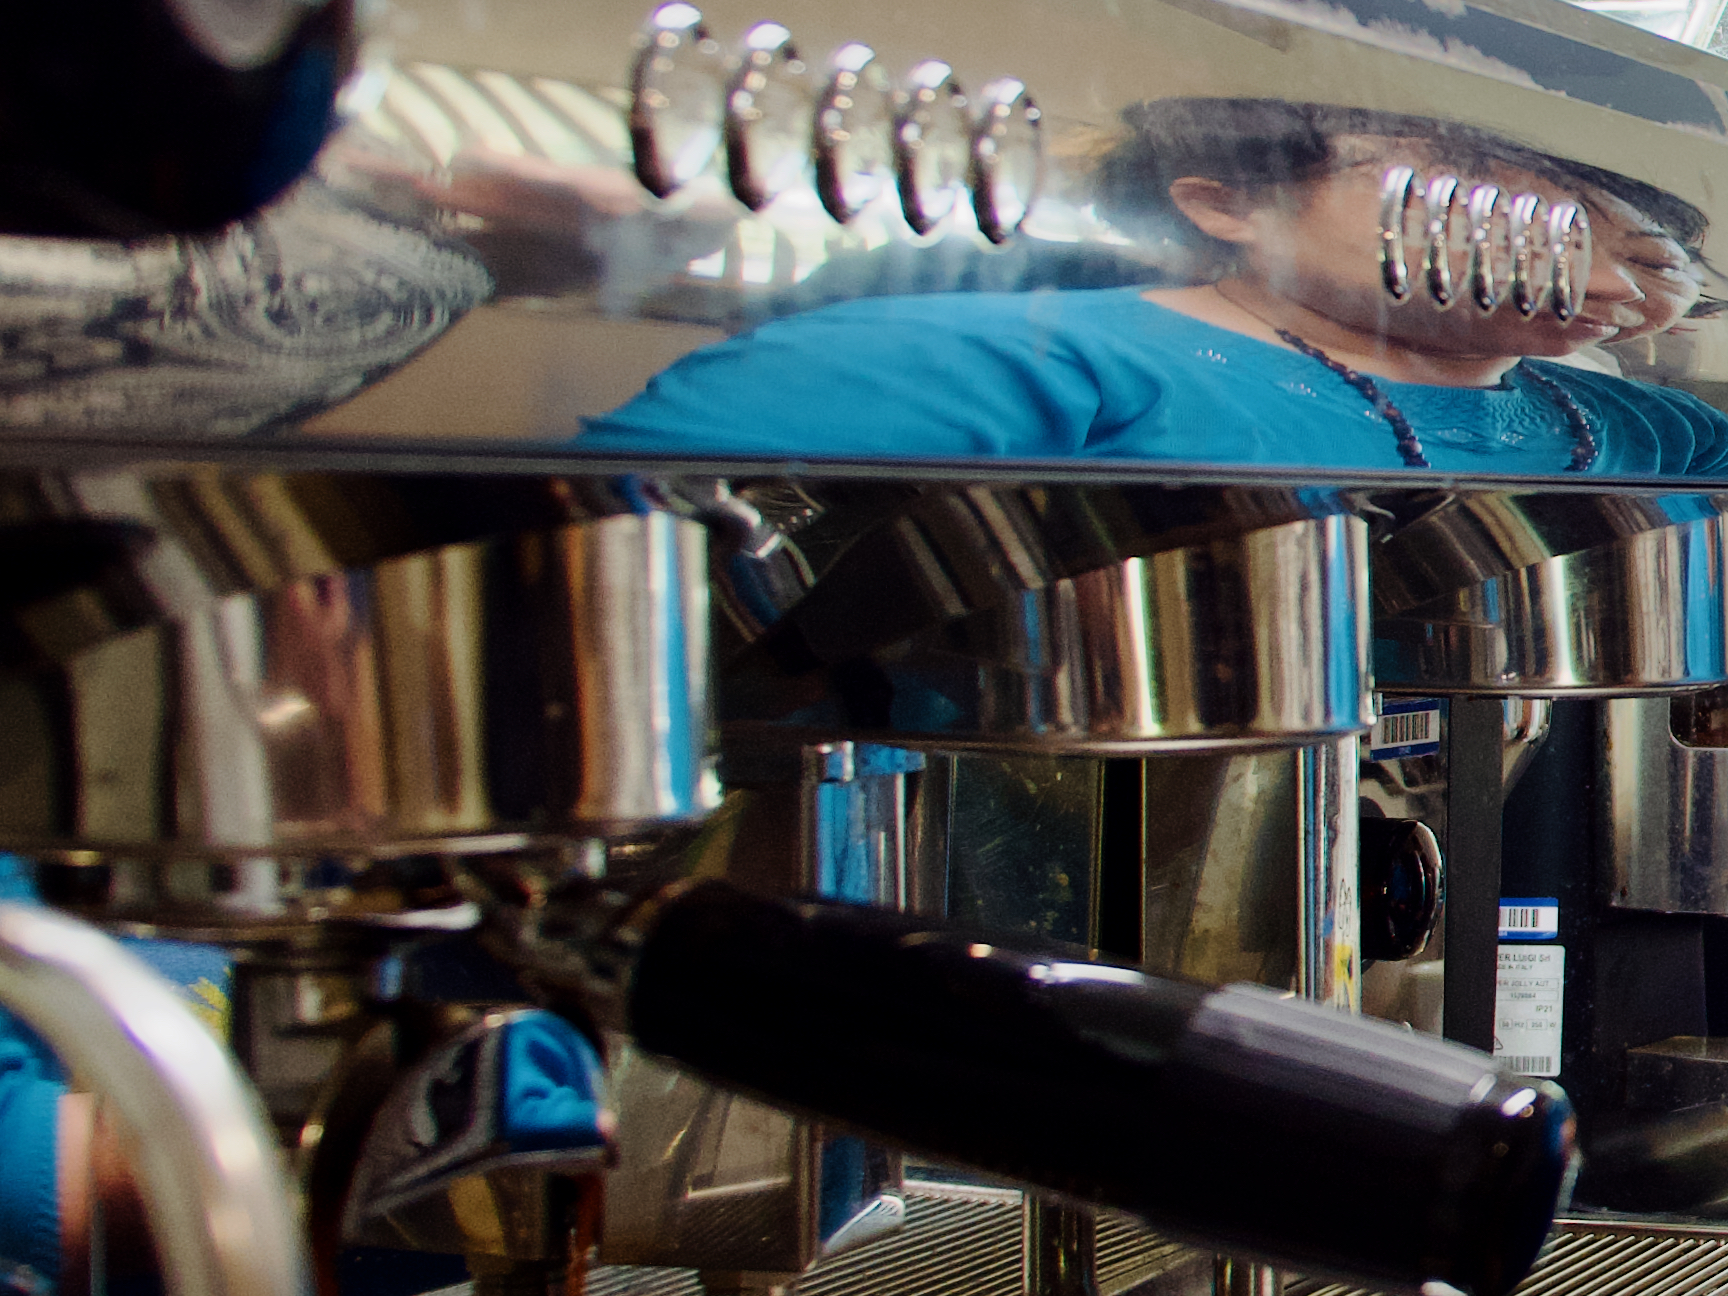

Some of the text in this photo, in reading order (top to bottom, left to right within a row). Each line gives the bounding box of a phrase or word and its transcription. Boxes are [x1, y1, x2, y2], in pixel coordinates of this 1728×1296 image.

[1498, 953, 1511, 962] ER
[1513, 953, 1537, 962] LUIGI
[1535, 1005, 1553, 1013] IP21
